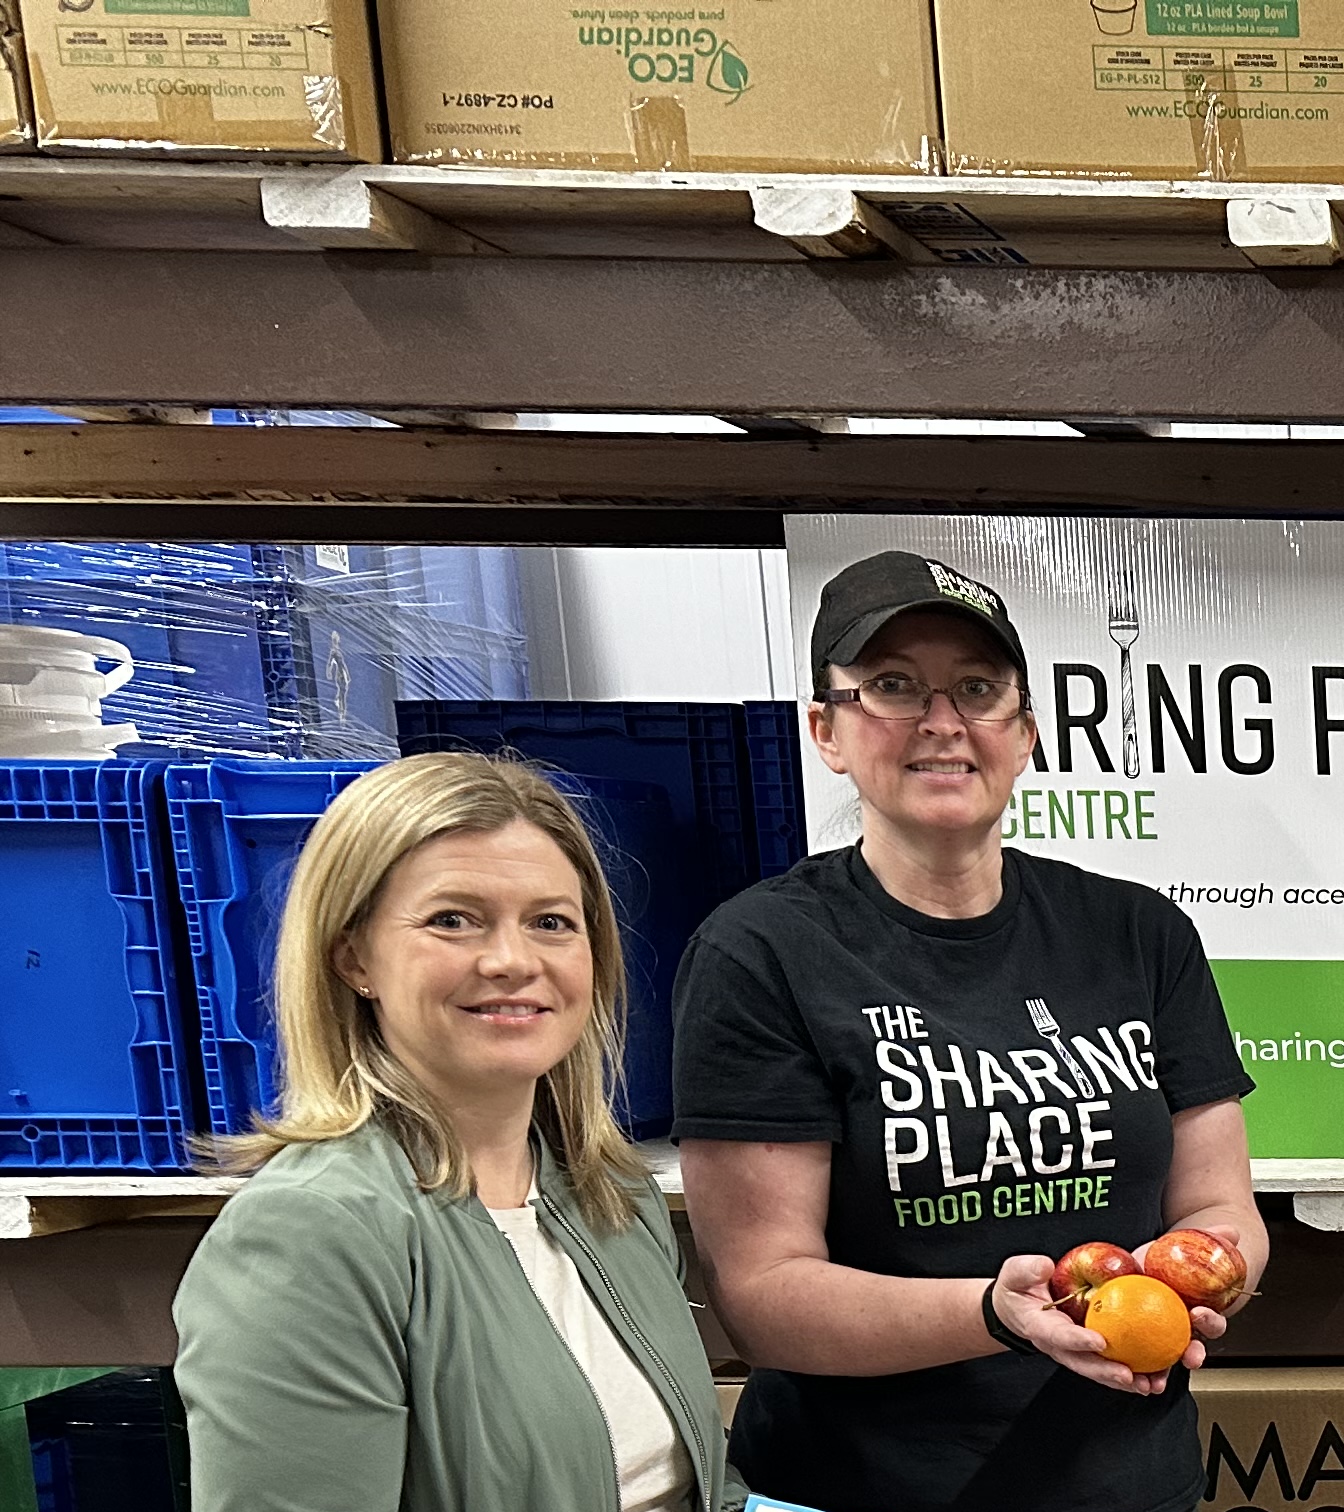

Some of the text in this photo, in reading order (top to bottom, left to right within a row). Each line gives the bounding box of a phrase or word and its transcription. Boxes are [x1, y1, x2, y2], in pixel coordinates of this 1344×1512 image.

[609, 10, 639, 22] clean
[699, 10, 724, 21] pure
[1157, 4, 1288, 21] 12 oz PLA Lined Soup Bowl
[579, 27, 717, 56] Guardian
[629, 54, 694, 83] ECO
[1250, 76, 1262, 87] 25
[1314, 76, 1327, 87] 20
[91, 78, 285, 100] www.ECOGuardian.com
[442, 94, 553, 108] PO# CZ-4897-1
[1000, 790, 1158, 840] CENTRE
[1169, 881, 1274, 908] through
[861, 1006, 929, 1039] THE
[875, 1011, 1159, 1111] SHARING
[884, 1101, 1116, 1191] PLACE
[894, 1176, 1112, 1228] FOOD CENTRE
